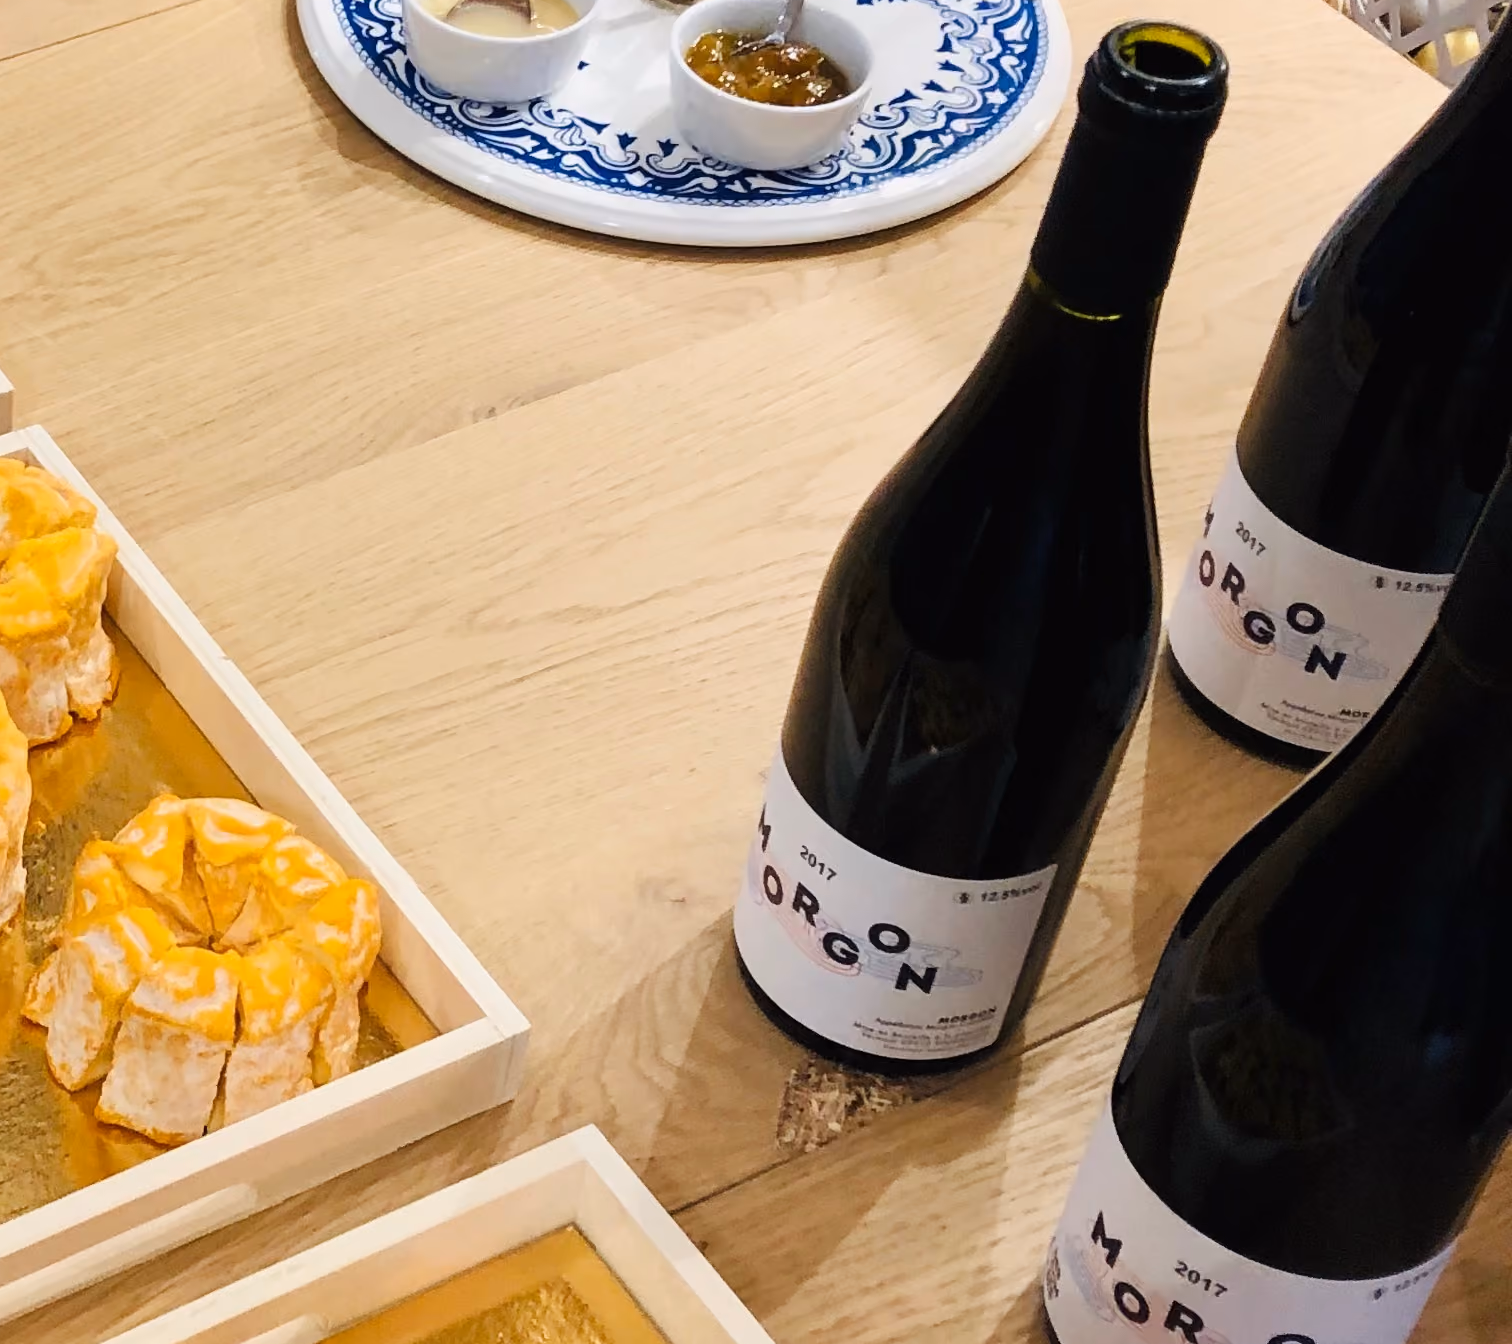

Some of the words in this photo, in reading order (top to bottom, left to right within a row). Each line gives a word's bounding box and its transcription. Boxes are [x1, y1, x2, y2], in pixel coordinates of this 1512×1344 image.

[1235, 521, 1266, 556] 2017
[799, 845, 837, 882] 2017
[758, 802, 938, 995] MORGON
[1174, 1260, 1228, 1299] 2017
